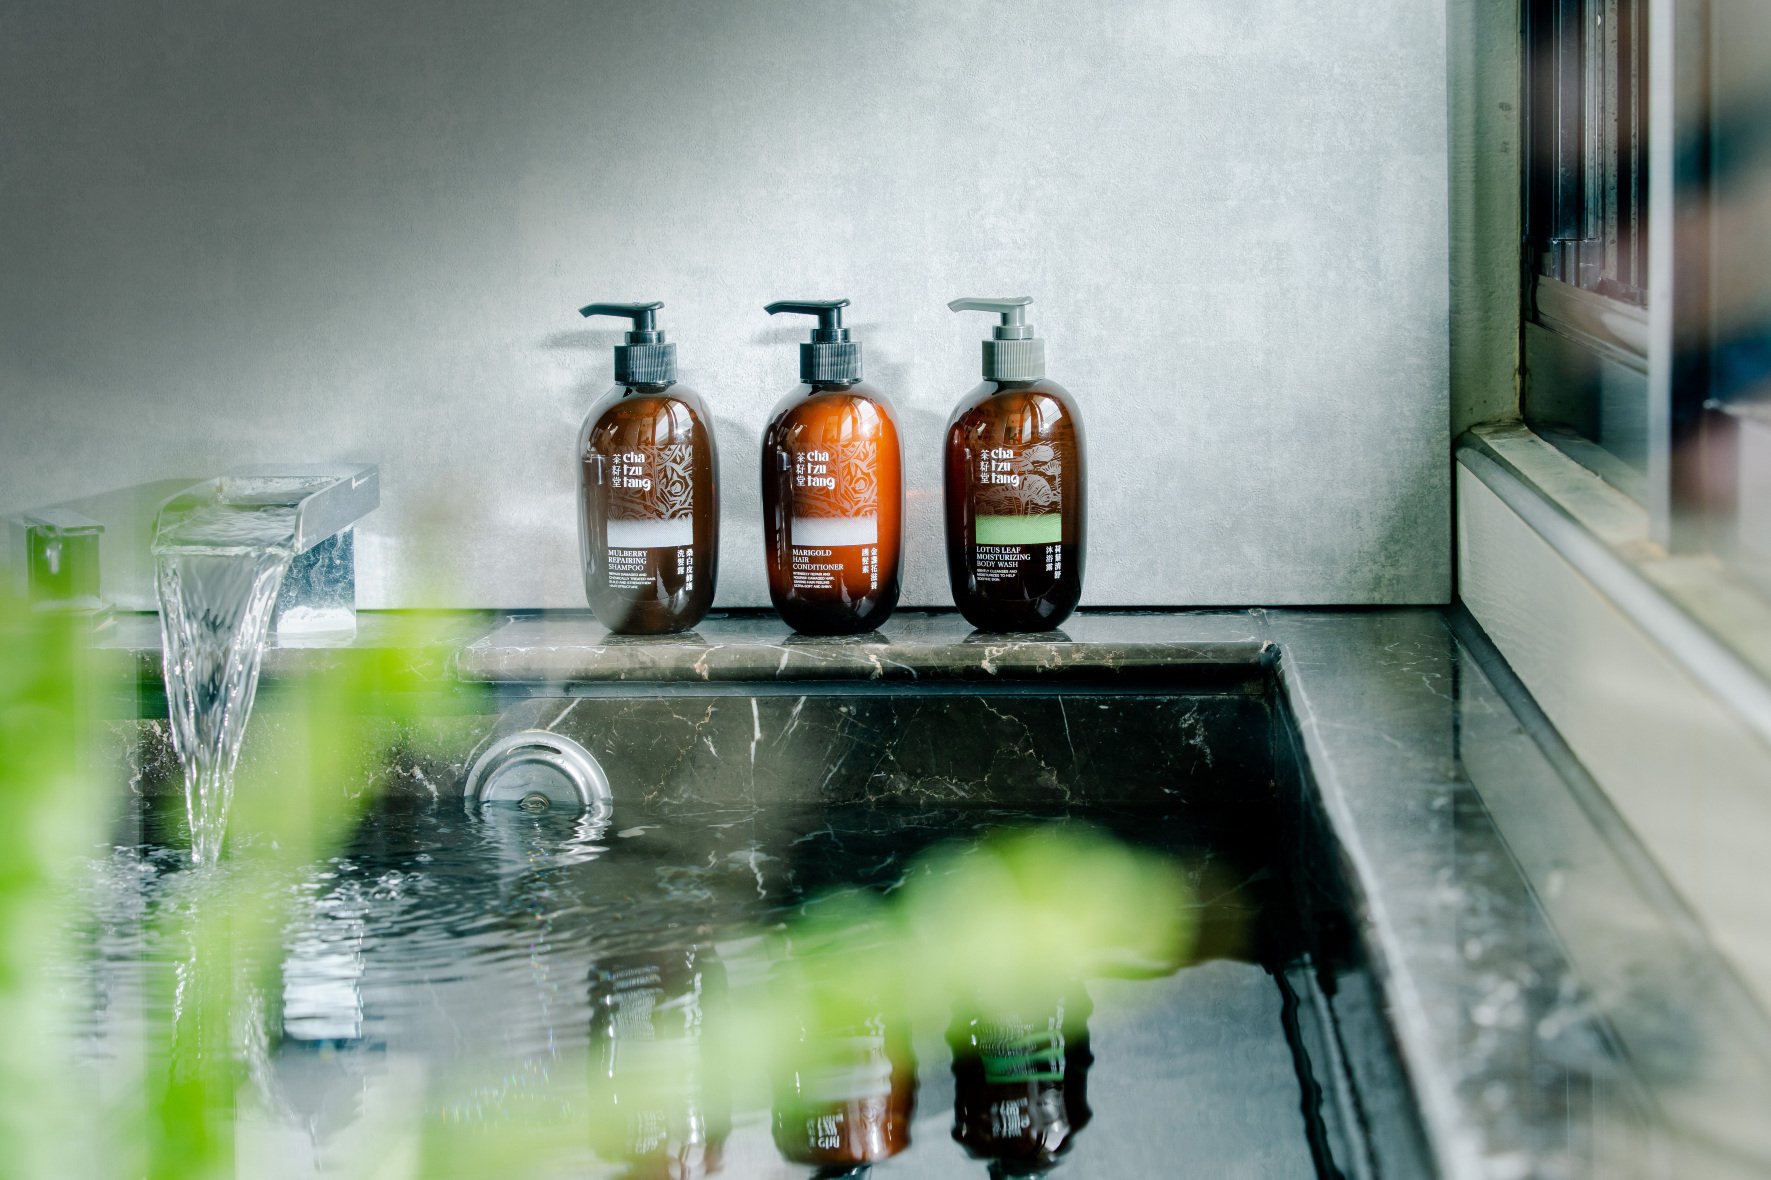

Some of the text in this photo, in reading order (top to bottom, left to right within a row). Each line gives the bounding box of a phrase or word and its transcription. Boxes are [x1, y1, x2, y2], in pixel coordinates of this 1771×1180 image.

[623, 452, 645, 463] cha
[807, 450, 829, 461] cha
[991, 448, 1013, 459] cha
[612, 454, 621, 487] 茶籽堂
[796, 452, 805, 486] 茶籽堂
[980, 450, 990, 484] 茶籽堂
[623, 478, 650, 491] tang
[807, 476, 835, 489] tang
[992, 474, 1019, 486] tang
